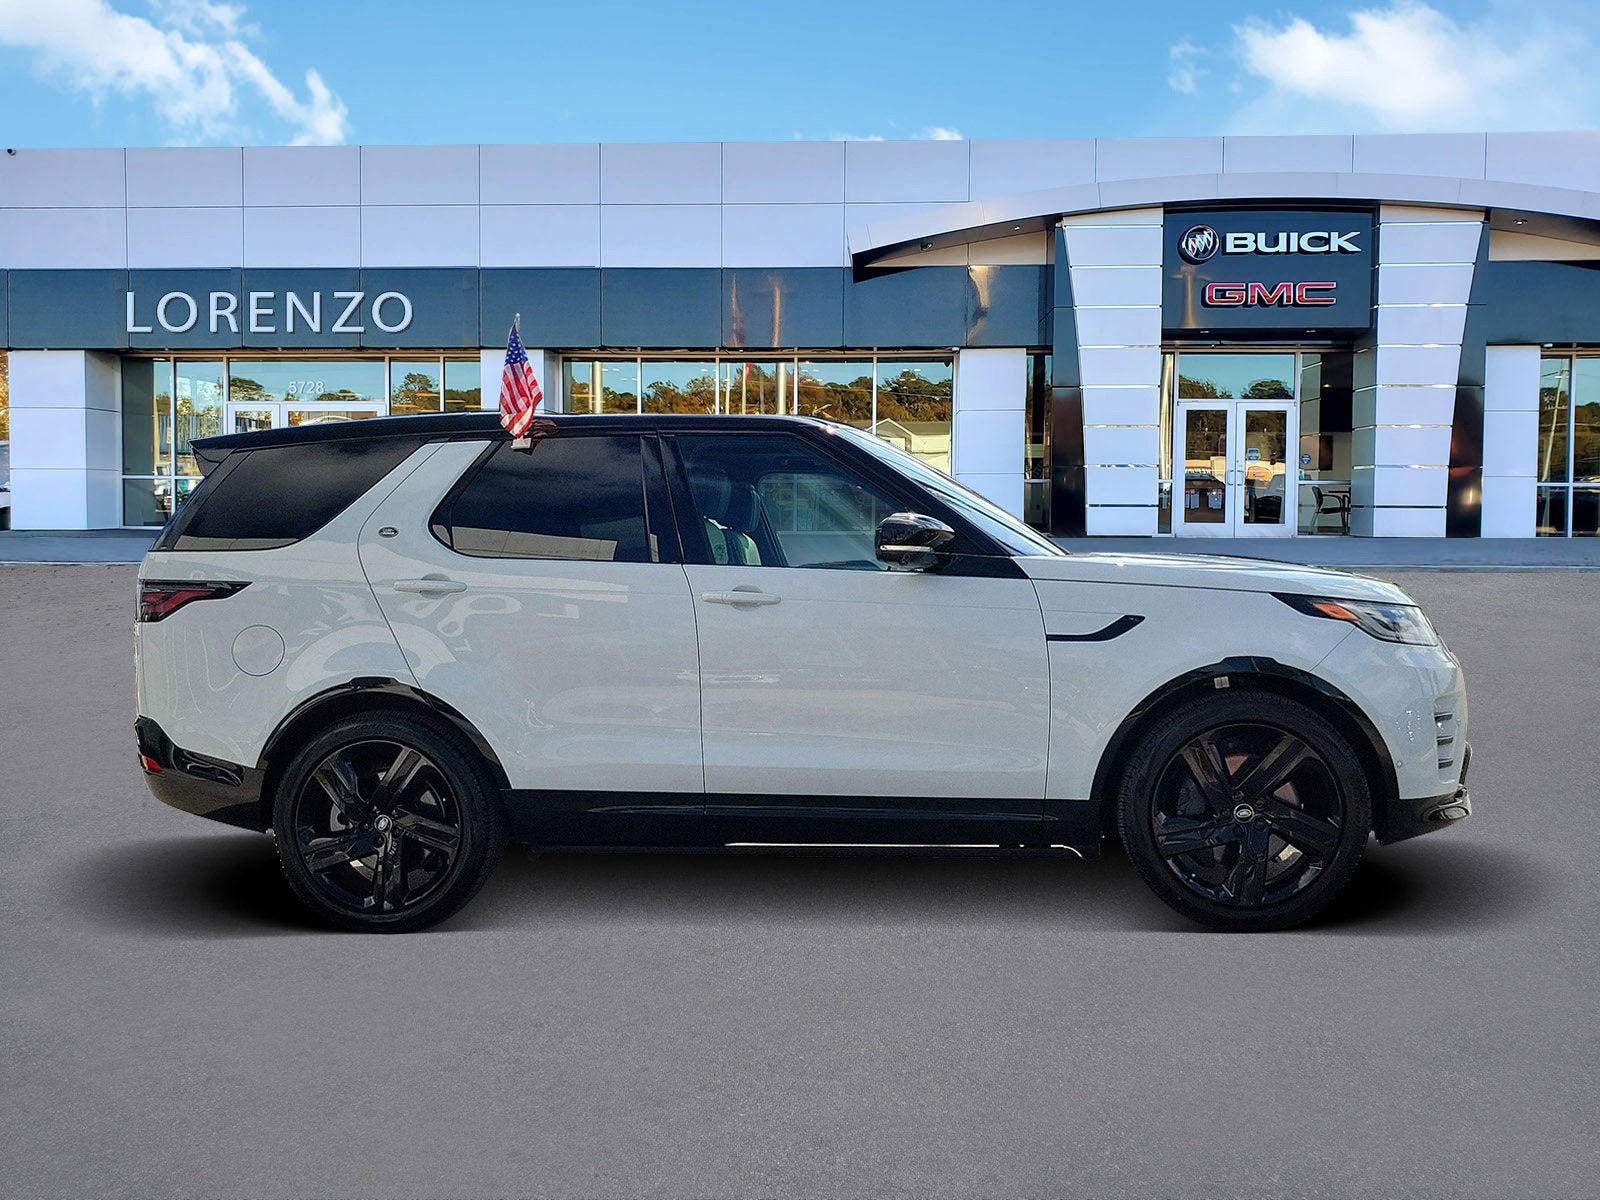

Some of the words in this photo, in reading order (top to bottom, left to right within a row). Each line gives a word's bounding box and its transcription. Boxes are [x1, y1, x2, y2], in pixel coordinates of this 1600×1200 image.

[1225, 231, 1361, 253] BUICK
[1205, 281, 1337, 305] GMC
[125, 291, 414, 334] LORENZO
[287, 380, 326, 395] 5728
